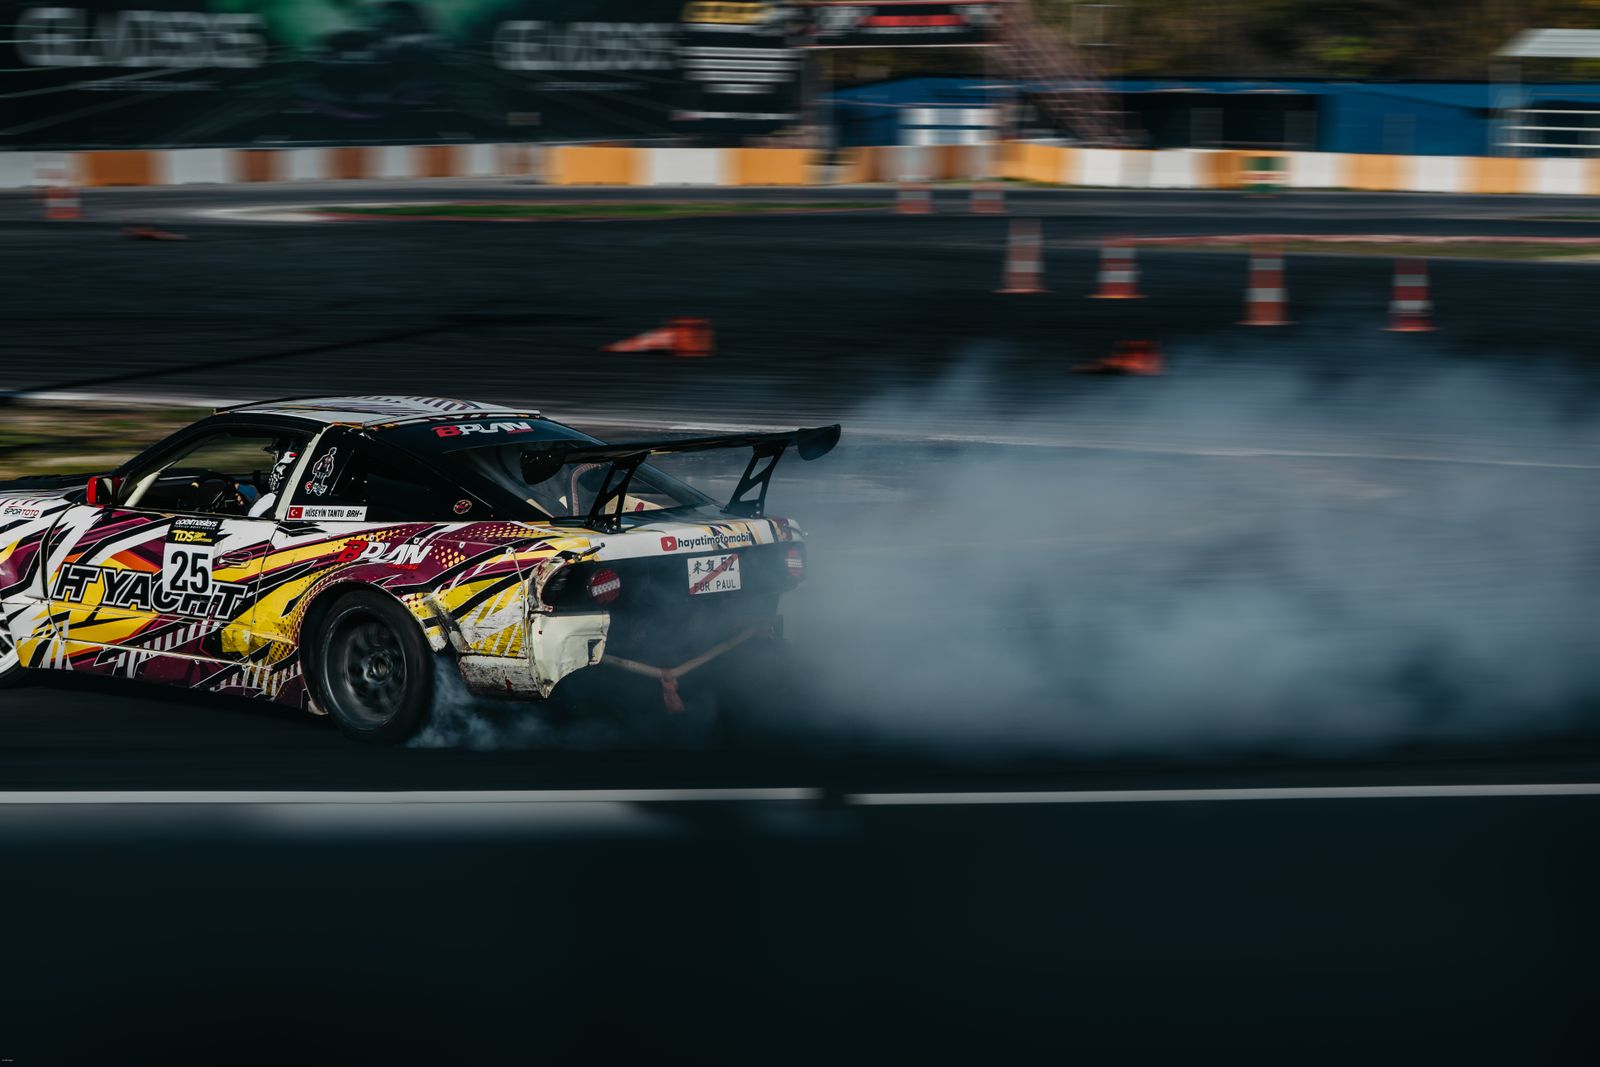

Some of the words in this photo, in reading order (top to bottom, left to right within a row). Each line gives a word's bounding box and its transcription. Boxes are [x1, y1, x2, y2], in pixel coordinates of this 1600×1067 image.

[431, 422, 533, 438] BPLAN
[305, 508, 327, 517] HÜSEYİN
[327, 509, 345, 517] TANTU
[336, 540, 434, 565] BPLAN
[170, 551, 209, 593] 25
[693, 581, 710, 592] FOR
[716, 578, 736, 590] PAUL
